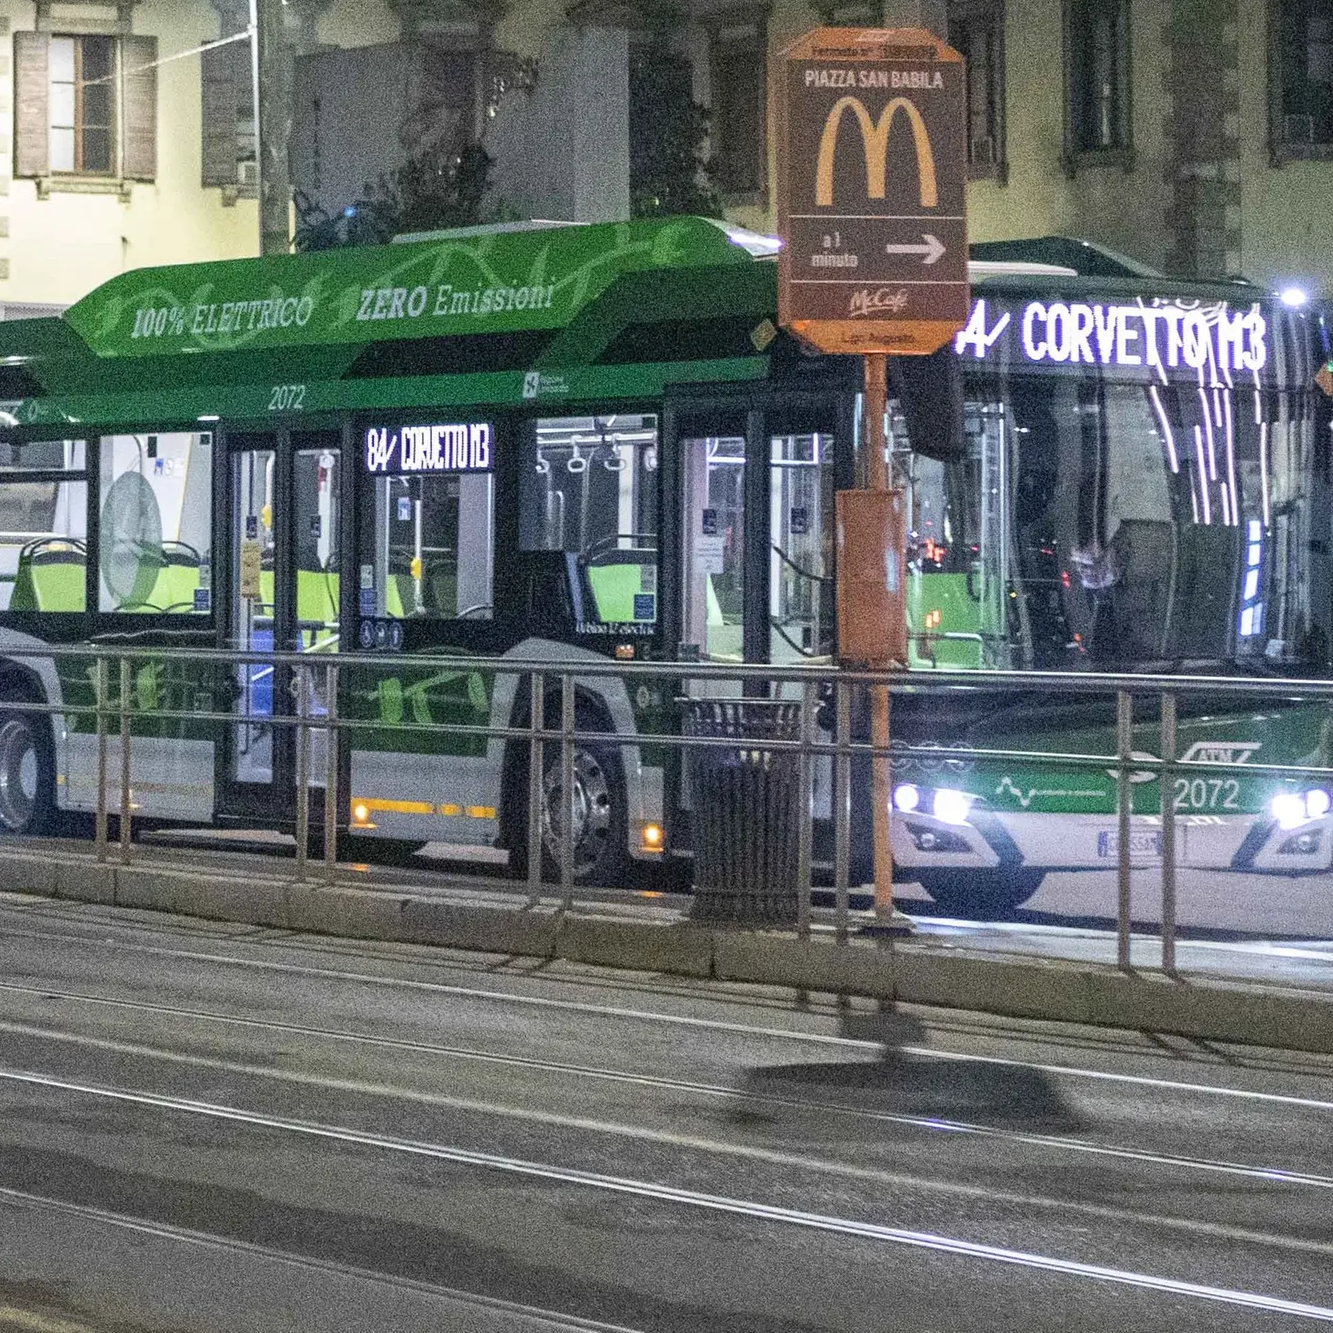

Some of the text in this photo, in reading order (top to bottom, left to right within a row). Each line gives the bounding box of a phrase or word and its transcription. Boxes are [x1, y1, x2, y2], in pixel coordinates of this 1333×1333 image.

[805, 70, 944, 90] PIAZZA SAN BABILA
[823, 232, 841, 248] a 1
[811, 253, 859, 268] minuto
[131, 276, 554, 338] 100% ELETTRICO ZERO Emissioni
[849, 288, 909, 315] McCafé
[955, 299, 1267, 369] 4/ CORVETTO M3
[268, 384, 306, 411] 2072
[367, 423, 490, 472] 84/ CORVETTO M3
[1198, 749, 1233, 763] ATM
[1174, 779, 1240, 810] 2072
